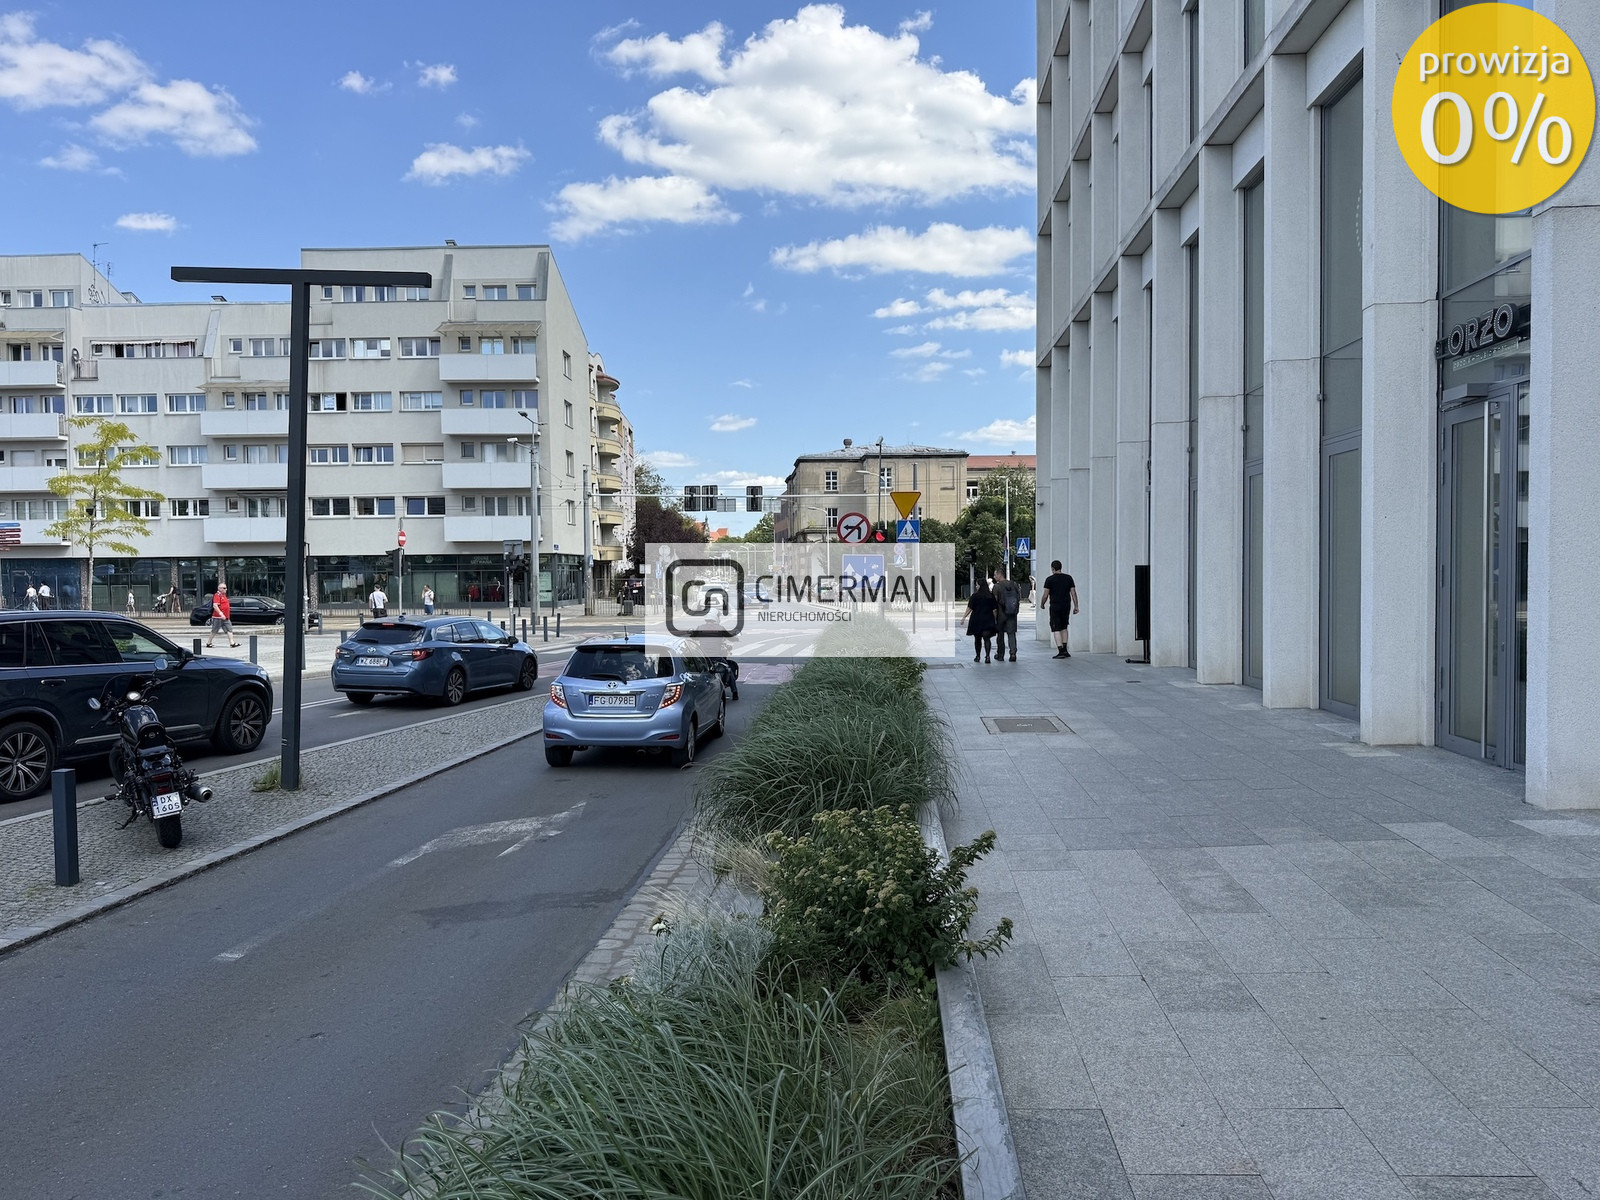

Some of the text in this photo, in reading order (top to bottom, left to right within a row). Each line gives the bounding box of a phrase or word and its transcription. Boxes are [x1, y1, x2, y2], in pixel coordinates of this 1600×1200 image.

[1447, 303, 1514, 356] ORZO
[593, 696, 634, 705] FG 0798E
[160, 795, 173, 804] DX
